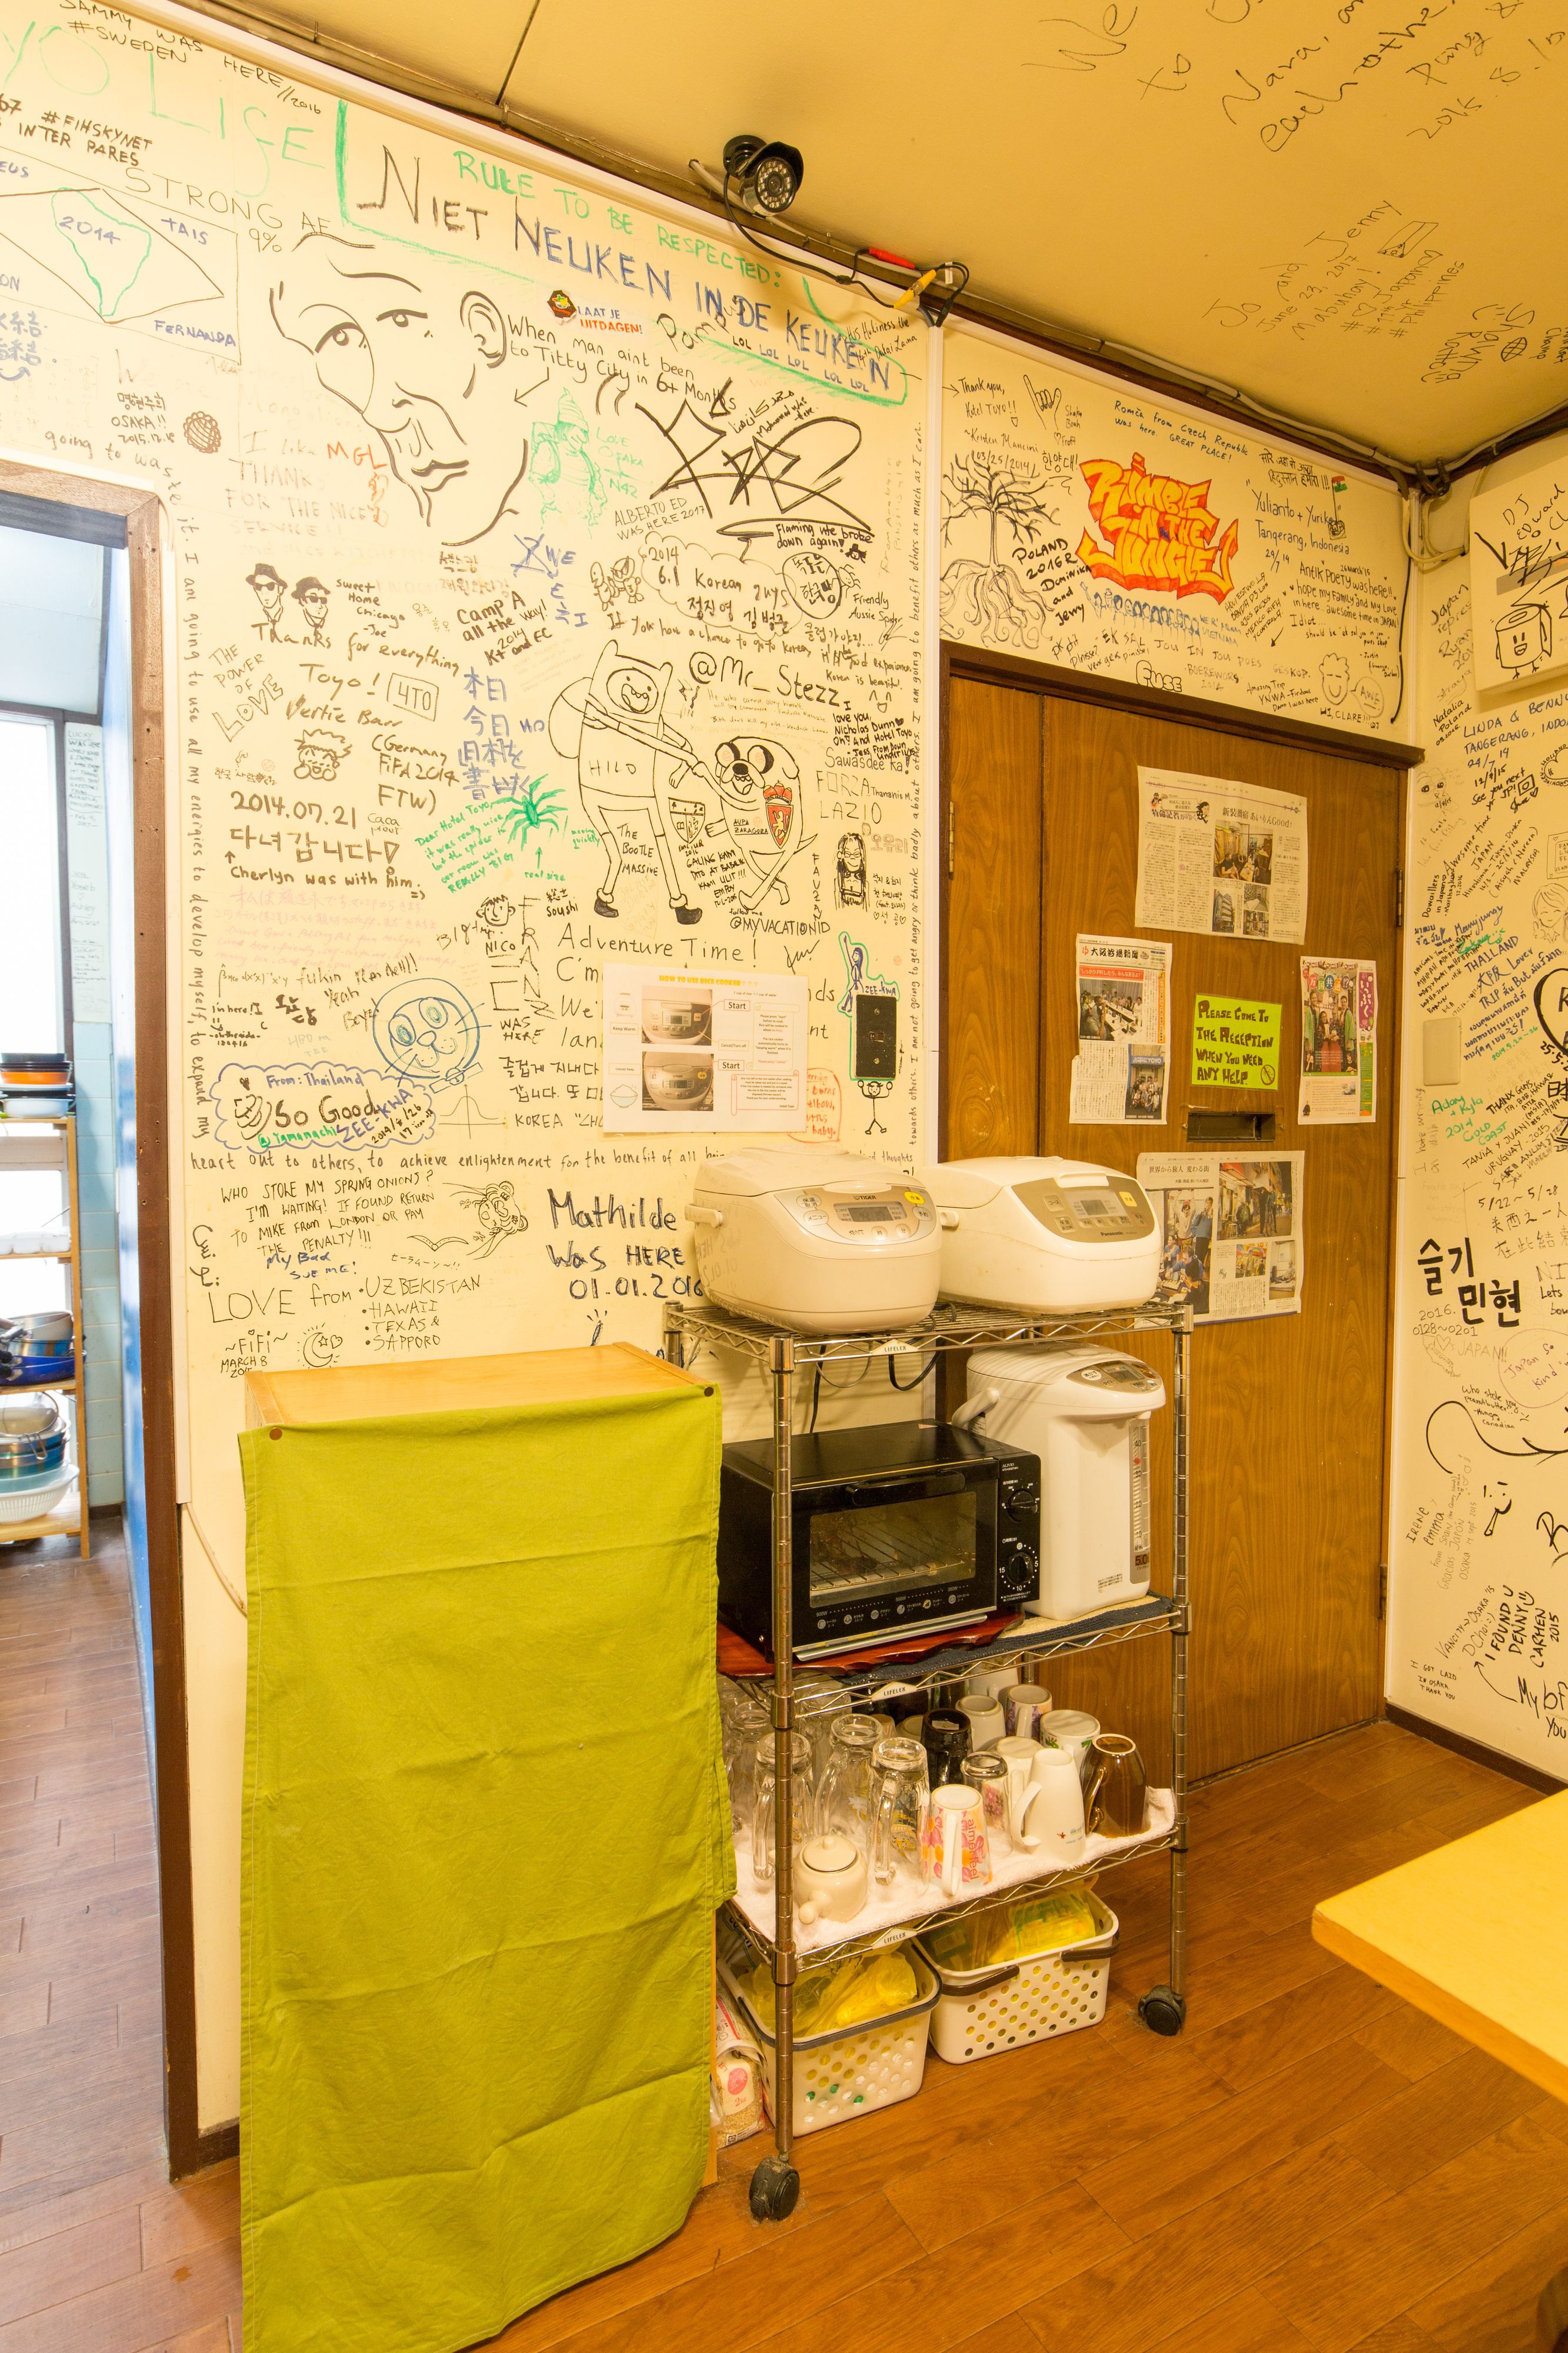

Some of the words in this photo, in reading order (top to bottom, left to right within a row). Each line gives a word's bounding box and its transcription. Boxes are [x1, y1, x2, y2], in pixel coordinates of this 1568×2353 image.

[68, 20, 187, 63] #SWEDEN
[156, 28, 205, 52] WAS
[88, 140, 140, 166] PARES
[124, 167, 283, 229] STRONG
[453, 150, 536, 199] RULE
[553, 188, 590, 219] TO
[608, 205, 634, 234] BE
[59, 215, 120, 244] 2014
[356, 145, 489, 241] NIET
[515, 196, 672, 301] NEUKEN
[696, 281, 722, 318] IN
[736, 295, 771, 332] DE
[786, 309, 890, 391] KEUKEN
[578, 305, 606, 319] LAAT
[610, 308, 620, 319] JE
[154, 319, 236, 346] FERNANDA
[579, 319, 643, 334] UITDAGEN!
[508, 314, 556, 344] When
[618, 348, 650, 367] aint
[660, 356, 694, 380] been
[733, 335, 752, 350] LOL
[788, 355, 809, 372] LOL
[511, 341, 529, 357] to
[533, 345, 587, 383] Titty
[596, 359, 630, 392] City
[637, 371, 648, 385] in
[958, 377, 985, 393] Thank
[1115, 418, 1131, 428] was
[1170, 434, 1195, 447] GREAT
[1153, 411, 1172, 428] from
[1180, 424, 1206, 441] Czech
[1215, 435, 1249, 456] Republic
[615, 499, 666, 526] ALBERTO
[1252, 489, 1295, 518] Yulianto
[617, 525, 643, 541] WAS
[648, 513, 679, 531] HERE
[680, 505, 705, 522] 2017
[776, 523, 815, 539] Flaming
[777, 535, 803, 549] down
[1012, 537, 1068, 565] POLAND
[1310, 532, 1350, 555] Indonesia
[1040, 565, 1092, 592] Dominika
[348, 592, 381, 606] Home
[511, 591, 526, 610] A
[853, 592, 889, 609] Friendly
[1053, 587, 1073, 605] and
[462, 622, 485, 642] all
[486, 615, 516, 633] the
[209, 644, 238, 666] THE
[348, 632, 369, 662] for
[378, 645, 460, 677] everything
[213, 654, 265, 688] POWER
[235, 678, 253, 694] OF
[212, 673, 283, 742] LOVE
[833, 712, 851, 723] love
[835, 724, 869, 735] Nicholas
[871, 720, 895, 732] Dunn
[874, 729, 895, 743] Hotel
[896, 728, 912, 739] Toyo
[1463, 717, 1503, 738] LINDA
[825, 746, 885, 770] Sawasdee
[230, 790, 356, 829] 2014.07.21
[735, 827, 768, 835] ZARAGOZA
[305, 874, 336, 885] was
[345, 869, 378, 886] with
[525, 870, 543, 879] real
[558, 922, 673, 957] Adventure
[680, 938, 758, 968] Time!
[1464, 936, 1519, 972] THAILAND
[716, 978, 741, 986] COOKER
[499, 1016, 531, 1031] WAS
[303, 1071, 365, 1087] Thailand
[275, 1099, 309, 1128] So
[318, 1089, 380, 1123] Good
[515, 1113, 563, 1129] KOREA
[190, 1152, 236, 1171] heart
[285, 1154, 300, 1167] to
[367, 1152, 384, 1168] to
[400, 1153, 448, 1168] achieve
[459, 1154, 552, 1173] enlightenment
[561, 1155, 579, 1172] for
[585, 1149, 606, 1169] the
[613, 1146, 656, 1165] benefit
[221, 1186, 249, 1204] WHO
[262, 1181, 297, 1201] STOLE
[306, 1180, 324, 1197] MY
[334, 1178, 373, 1195] SPRING
[337, 1199, 352, 1213] IF
[355, 1194, 394, 1211] FOUND
[400, 1192, 435, 1207] RETURN
[546, 1188, 678, 1231] Mathilde
[231, 1229, 248, 1247] TO
[258, 1224, 286, 1241] MIKE
[328, 1214, 375, 1229] LONDON
[382, 1209, 398, 1222] OR
[404, 1207, 424, 1221] PAY
[626, 1244, 686, 1270] HERE
[1417, 1237, 1474, 1297] 슬기
[365, 1275, 481, 1297] UZBEKISTAN
[208, 1287, 296, 1324] LOVE
[373, 1320, 426, 1334] TEXAS
[373, 1334, 441, 1352] SAPPORO
[883, 1345, 907, 1354] LIFELEX
[1491, 1602, 1514, 1651] FOUND
[1509, 1604, 1529, 1655] DENNY
[883, 1687, 906, 1697] LIFELEX
[967, 1819, 975, 1850] aimer
[969, 1857, 979, 1880] feel
[883, 1932, 906, 1945] LIFELEX
